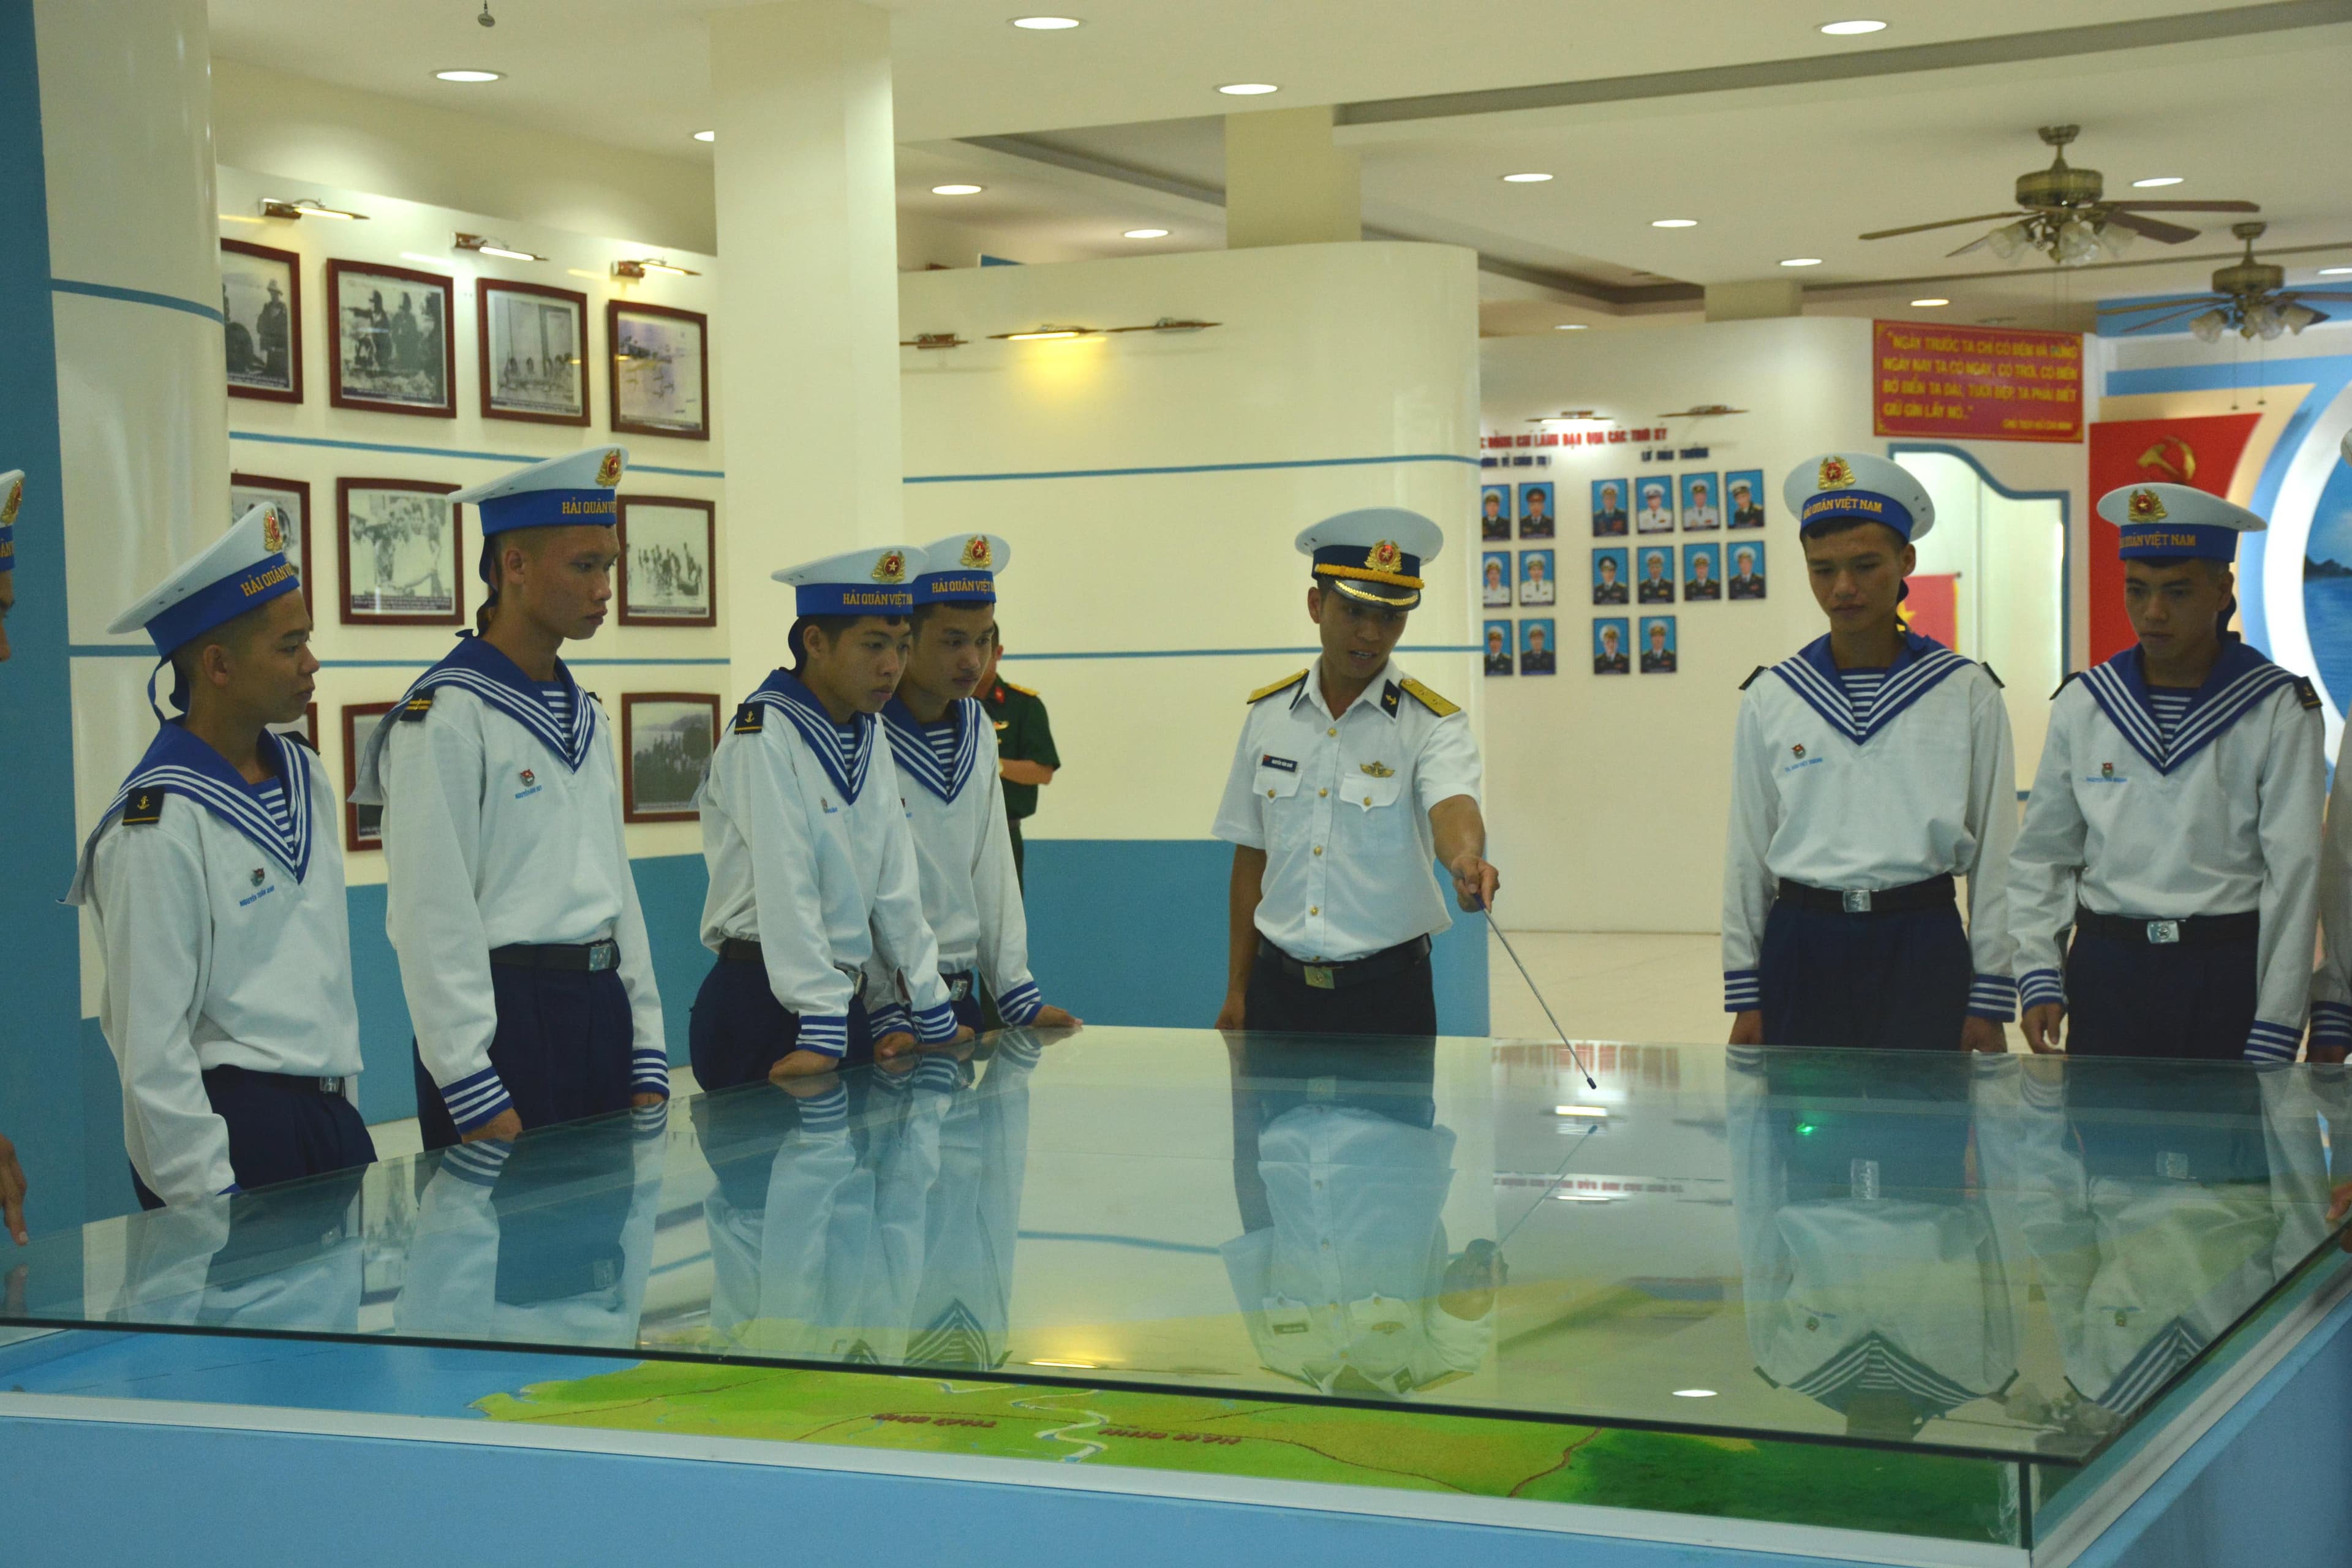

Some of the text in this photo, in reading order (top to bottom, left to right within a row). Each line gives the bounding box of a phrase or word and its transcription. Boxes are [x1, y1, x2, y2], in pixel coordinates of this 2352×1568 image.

[562, 496, 581, 514] HẢI
[583, 498, 608, 514] QUÂN
[1835, 496, 1859, 511] VIỆT
[1860, 499, 1882, 513] NAM
[2171, 534, 2196, 546] NAM
[240, 575, 265, 597] HẢI
[262, 565, 290, 587] QUÂN
[932, 578, 948, 593] HẢI
[949, 578, 974, 592] QUÂN
[843, 589, 860, 605] HẢI
[861, 590, 888, 605] QUÂN
[889, 590, 907, 608] VIỆT
